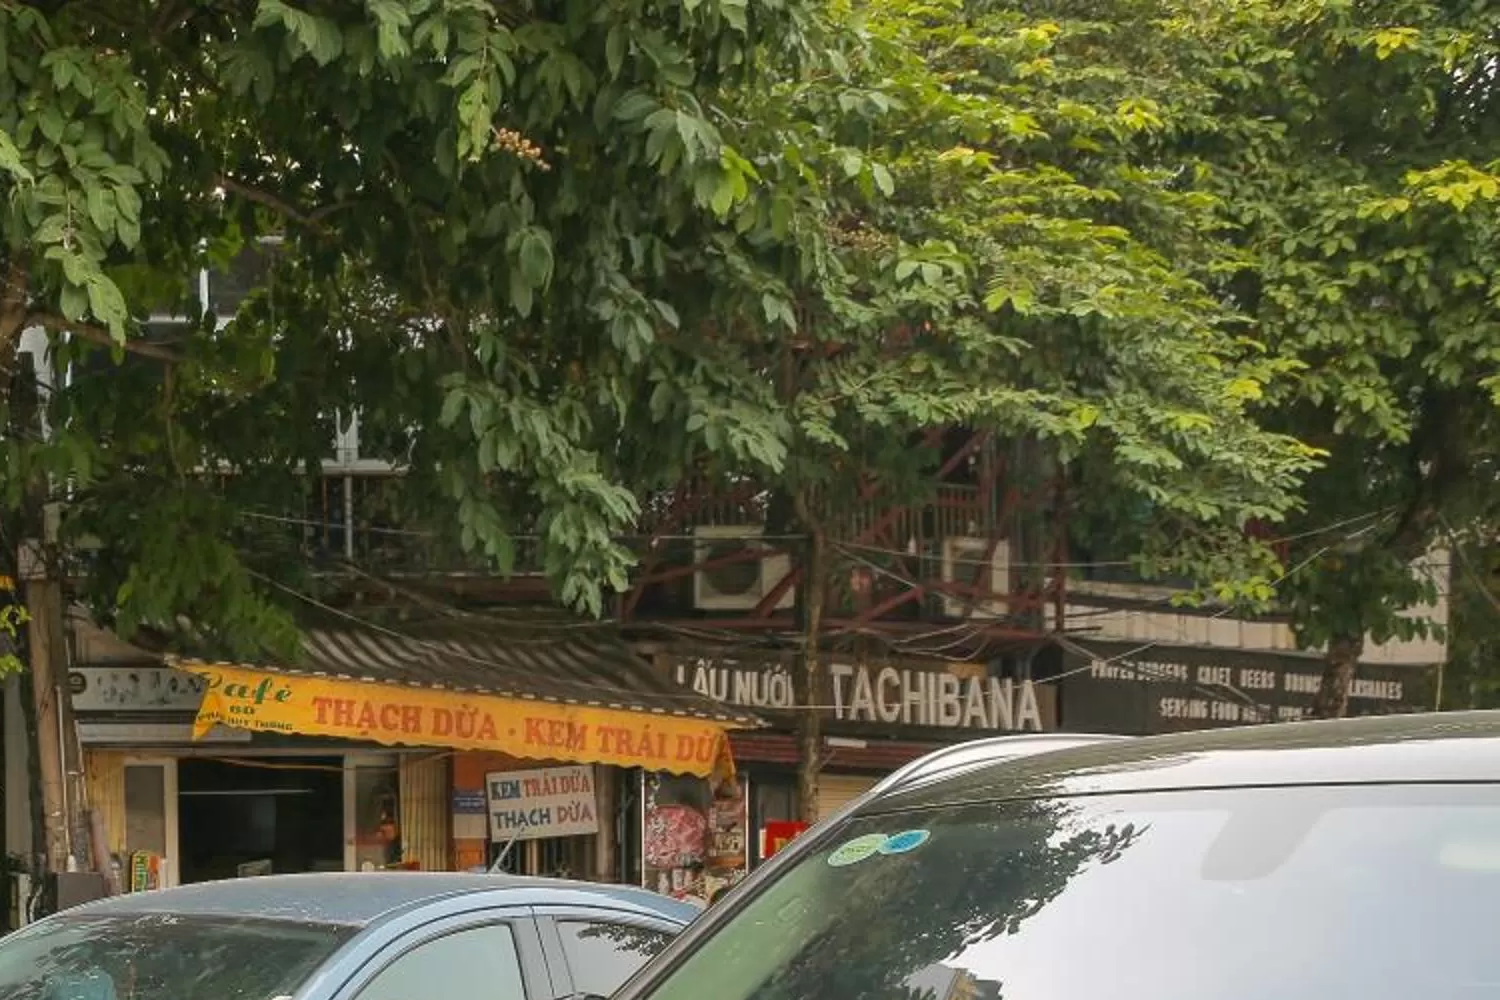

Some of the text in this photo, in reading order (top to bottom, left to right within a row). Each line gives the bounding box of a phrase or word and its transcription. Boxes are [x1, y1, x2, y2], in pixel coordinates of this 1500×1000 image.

[830, 664, 1043, 731] TACHIBANA
[312, 696, 423, 735] THẠCH
[432, 704, 500, 740] DỪA
[524, 717, 588, 752] KEM
[596, 724, 668, 759] TRÁI
[523, 773, 558, 797] TRÁI
[493, 801, 593, 832] THẠCH DỪA
